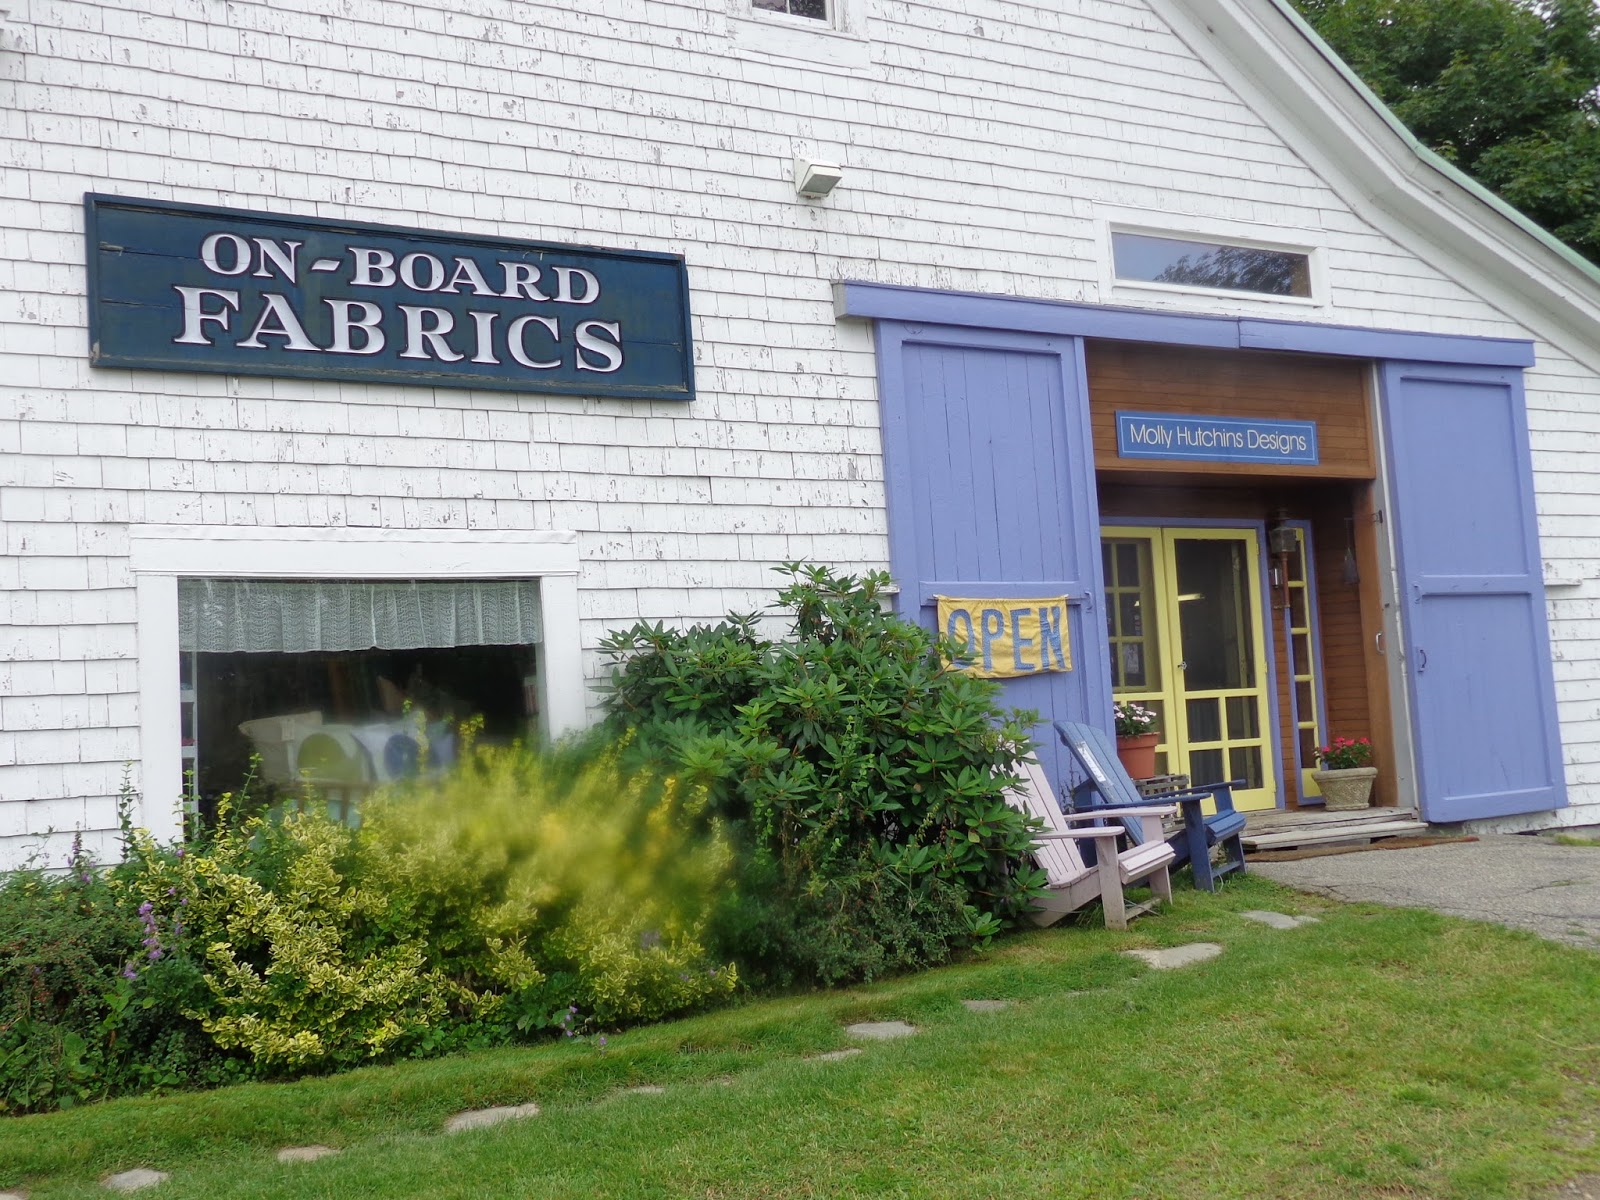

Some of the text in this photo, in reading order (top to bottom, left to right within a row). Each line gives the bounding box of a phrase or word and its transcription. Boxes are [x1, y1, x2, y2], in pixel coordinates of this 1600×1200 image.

[173, 286, 624, 373] FABRICS
[1130, 424, 1307, 454] Molly Hutchins Designs
[947, 605, 1066, 672] OPEN
